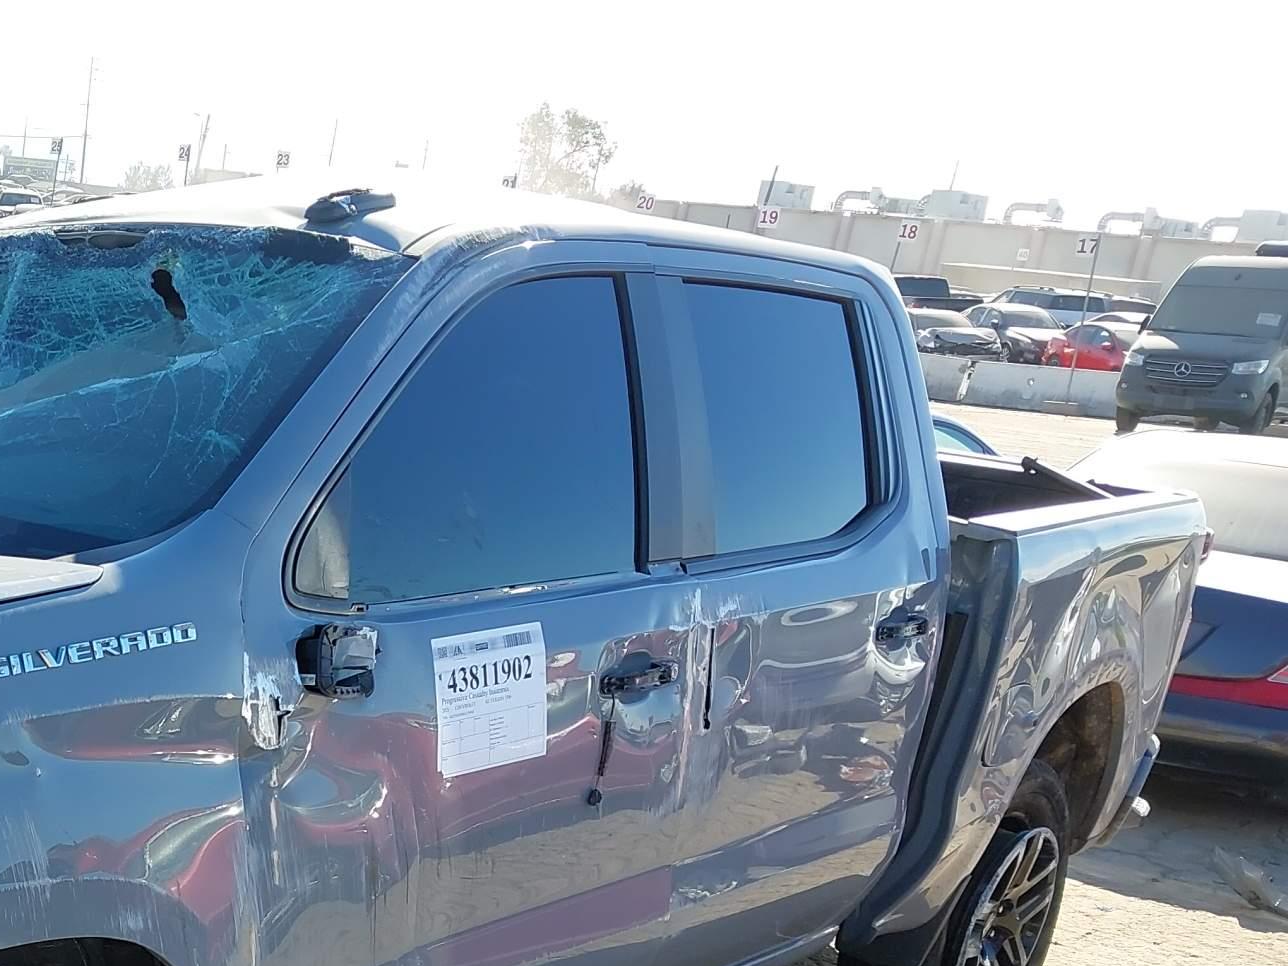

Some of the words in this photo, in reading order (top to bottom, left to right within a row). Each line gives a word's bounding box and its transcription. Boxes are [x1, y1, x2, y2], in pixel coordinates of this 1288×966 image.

[178, 146, 190, 159] 24
[276, 153, 290, 166] 23
[637, 195, 654, 210] 20
[760, 210, 779, 224] 19
[899, 223, 919, 239] 18
[1076, 238, 1099, 254] 17
[447, 654, 532, 693] 43811902
